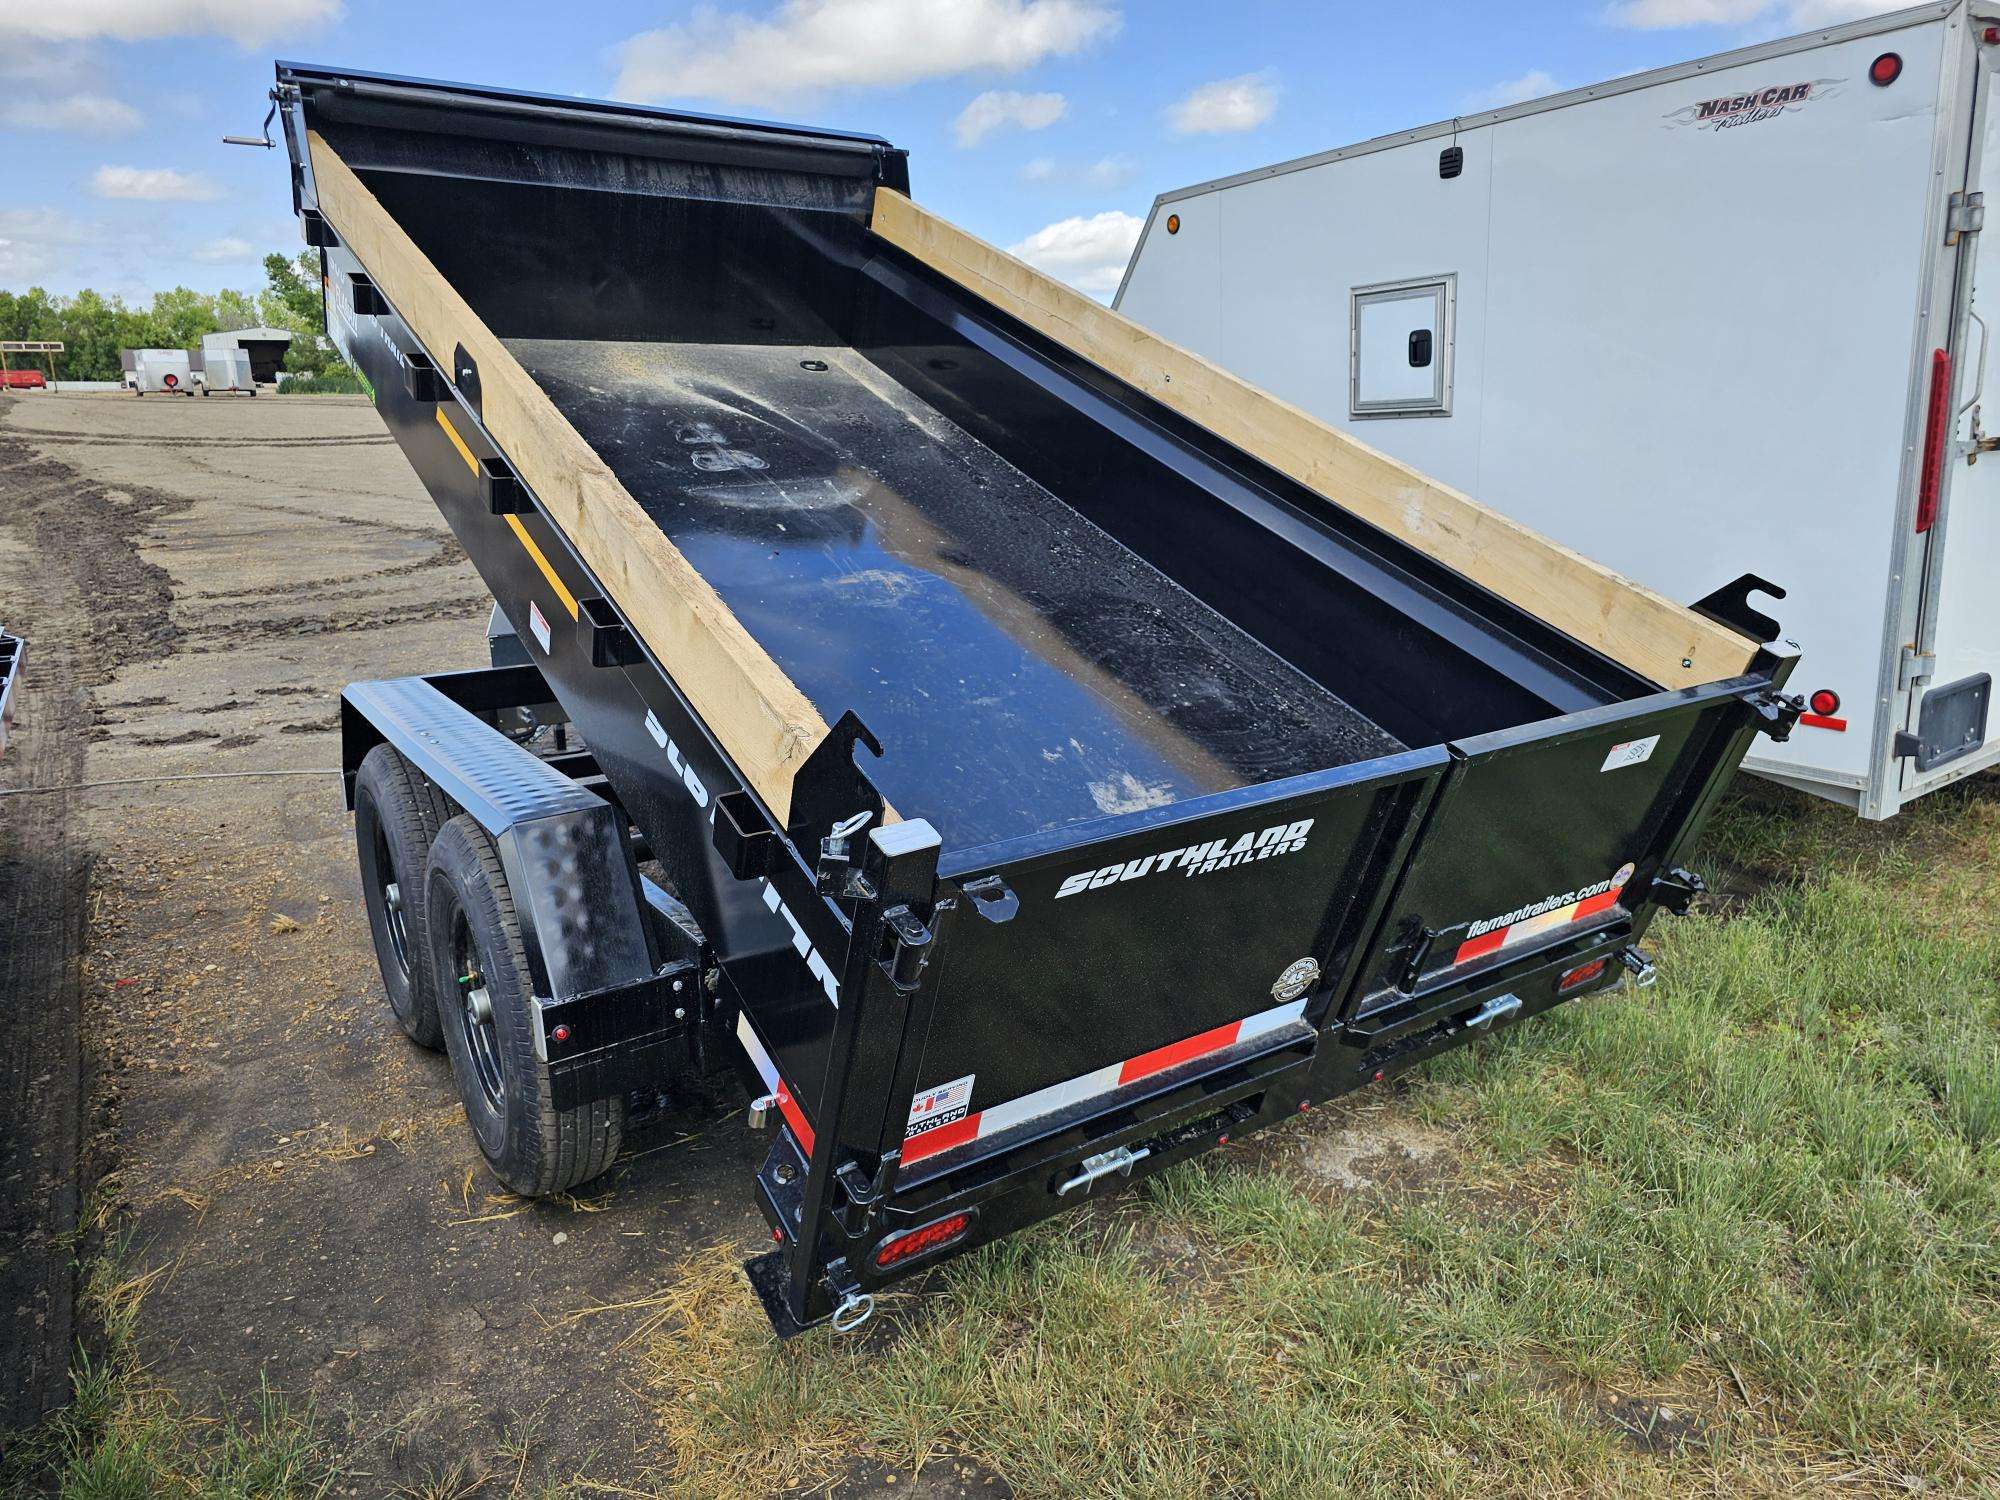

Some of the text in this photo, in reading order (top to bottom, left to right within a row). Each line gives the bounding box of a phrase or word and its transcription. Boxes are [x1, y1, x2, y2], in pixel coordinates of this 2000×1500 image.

[1697, 83, 1811, 118] NASH CAR
[1054, 818, 1315, 900] SOUTHLAND
[1185, 837, 1308, 878] TRAILERS
[1466, 879, 1611, 939] flamantrailers.com
